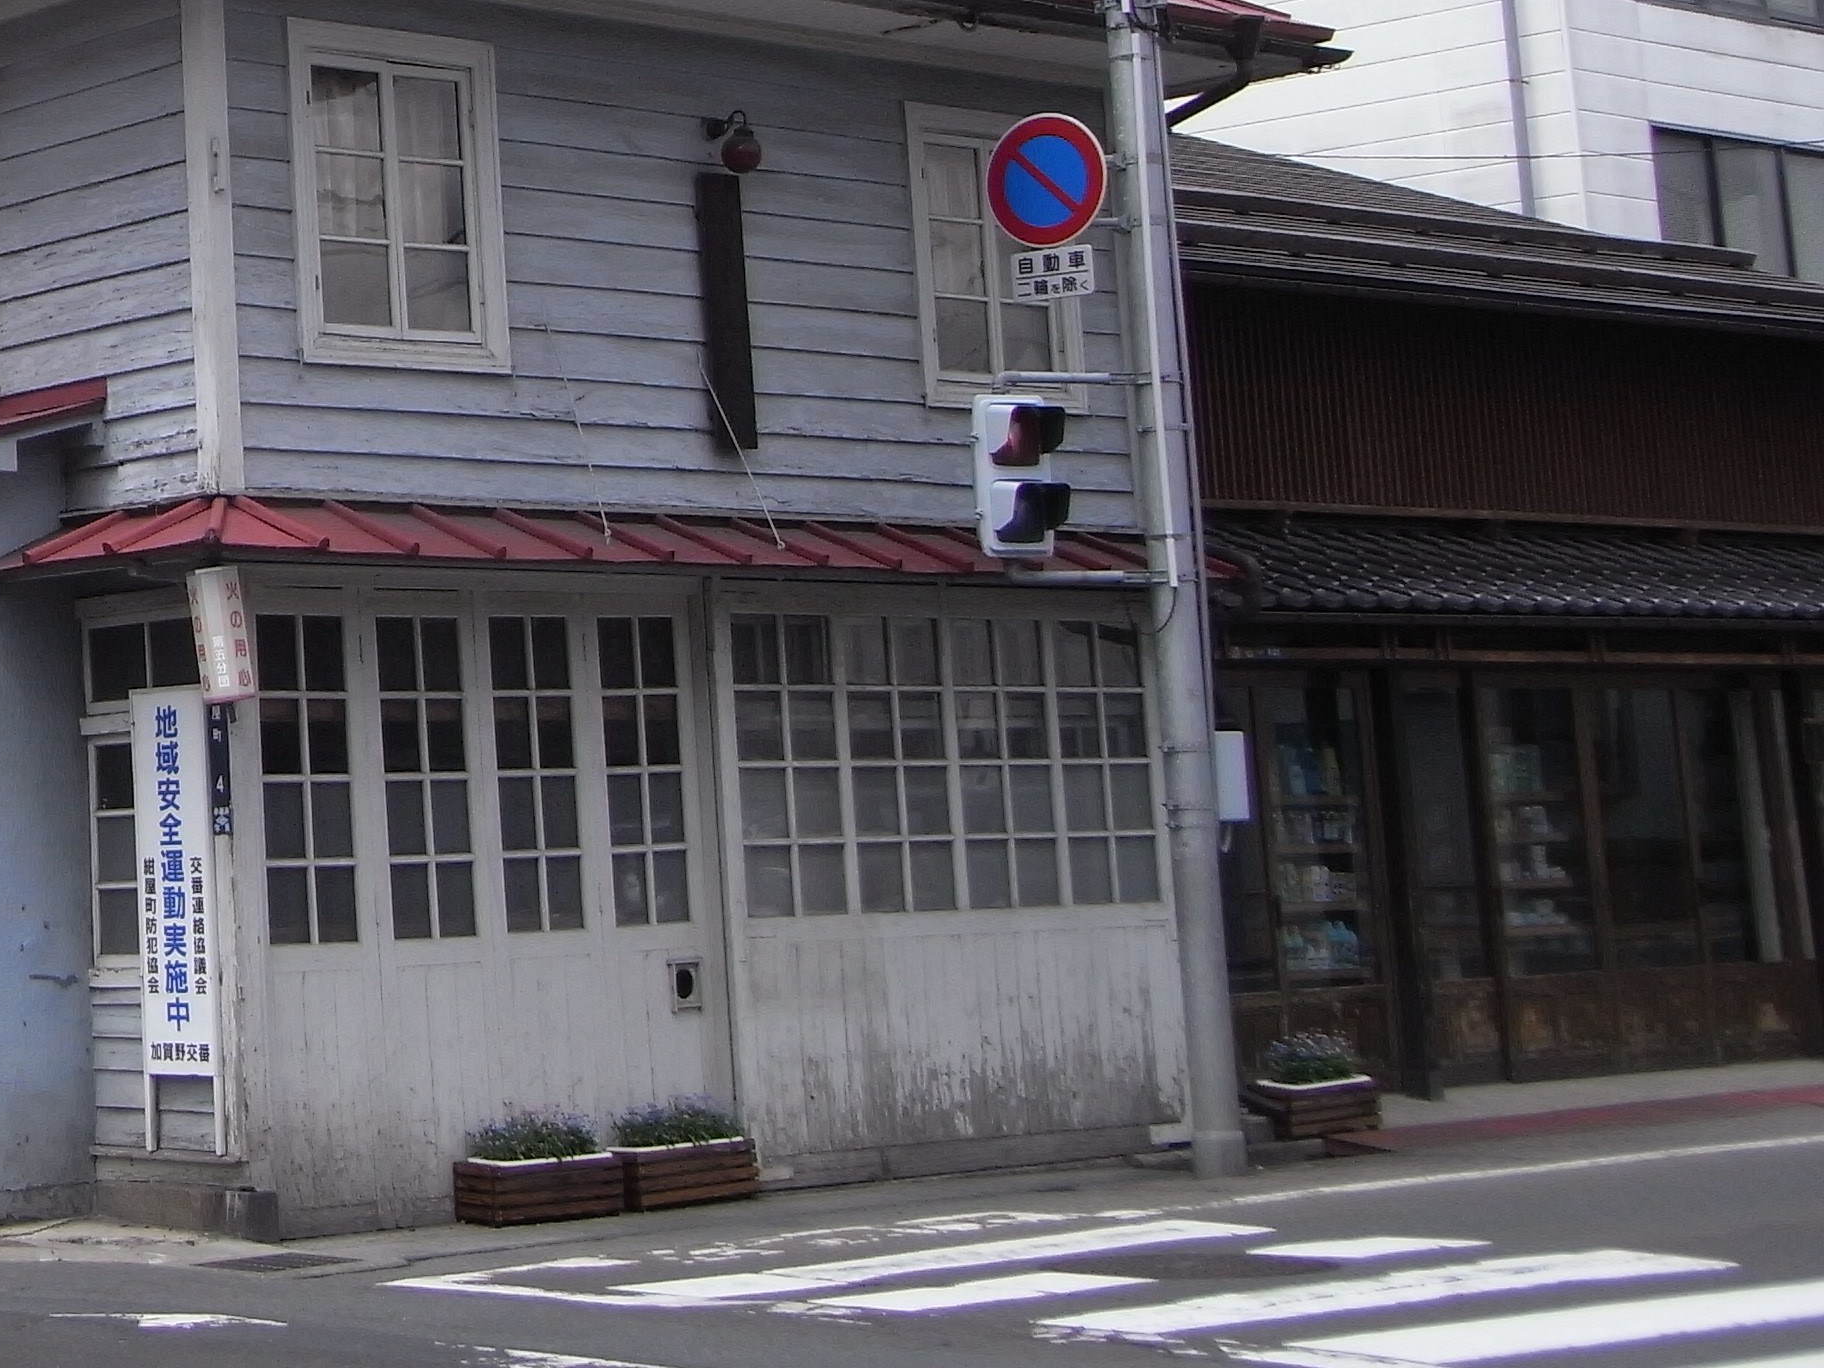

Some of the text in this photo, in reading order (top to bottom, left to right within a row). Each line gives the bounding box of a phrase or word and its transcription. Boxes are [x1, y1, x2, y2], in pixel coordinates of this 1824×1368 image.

[1017, 275, 1090, 298] 二輪を除く
[1018, 250, 1086, 275] 自動車
[225, 580, 252, 688] 火の用心
[216, 774, 225, 793] 4
[154, 704, 191, 1032] 地域安全運動実施中
[143, 857, 160, 995] 紺屋町防犯協会
[189, 856, 208, 995] 交番連絡協議会
[150, 1041, 211, 1063] 加賀野交番
